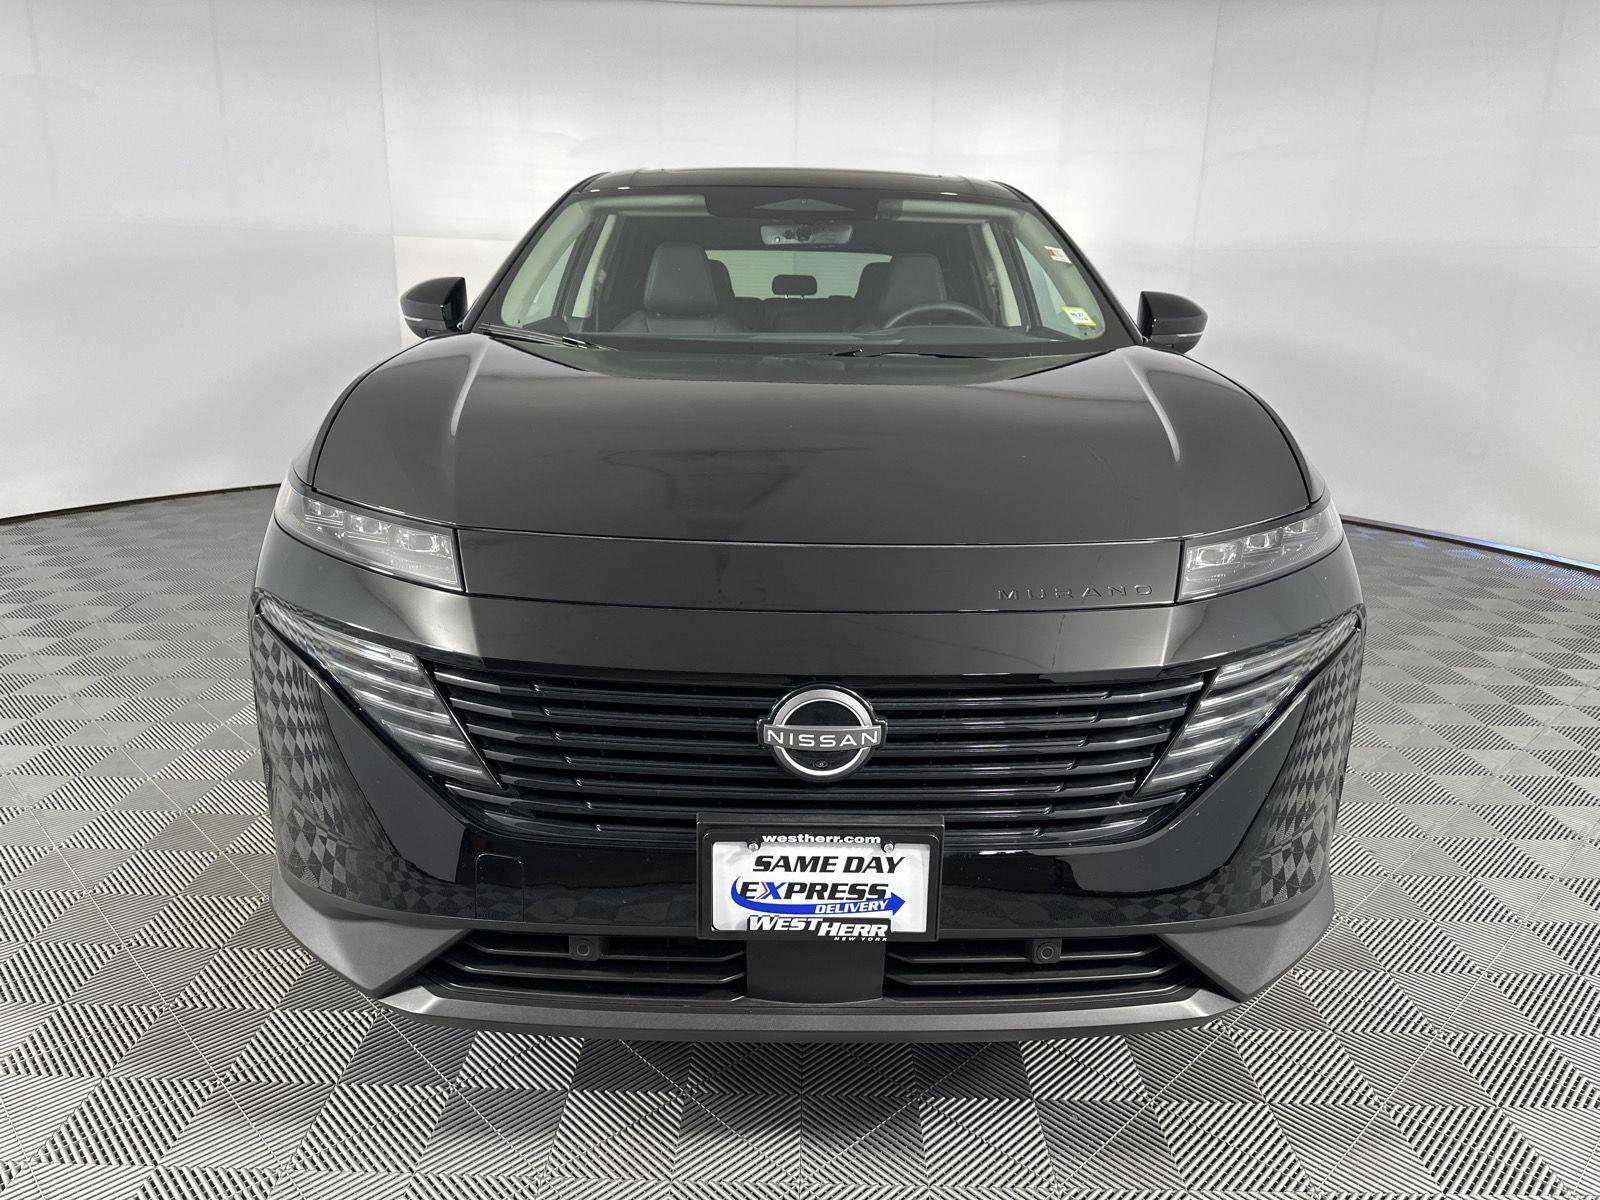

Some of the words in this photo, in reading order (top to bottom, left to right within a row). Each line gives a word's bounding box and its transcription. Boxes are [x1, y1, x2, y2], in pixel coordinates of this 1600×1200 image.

[998, 584, 1153, 601] MURANO
[767, 729, 878, 748] NISSAN
[762, 833, 881, 844] westherr.com
[753, 855, 838, 873] SAME
[842, 856, 905, 874] DAY
[739, 881, 889, 900] EXPRESS
[814, 899, 889, 914] DELIVERY
